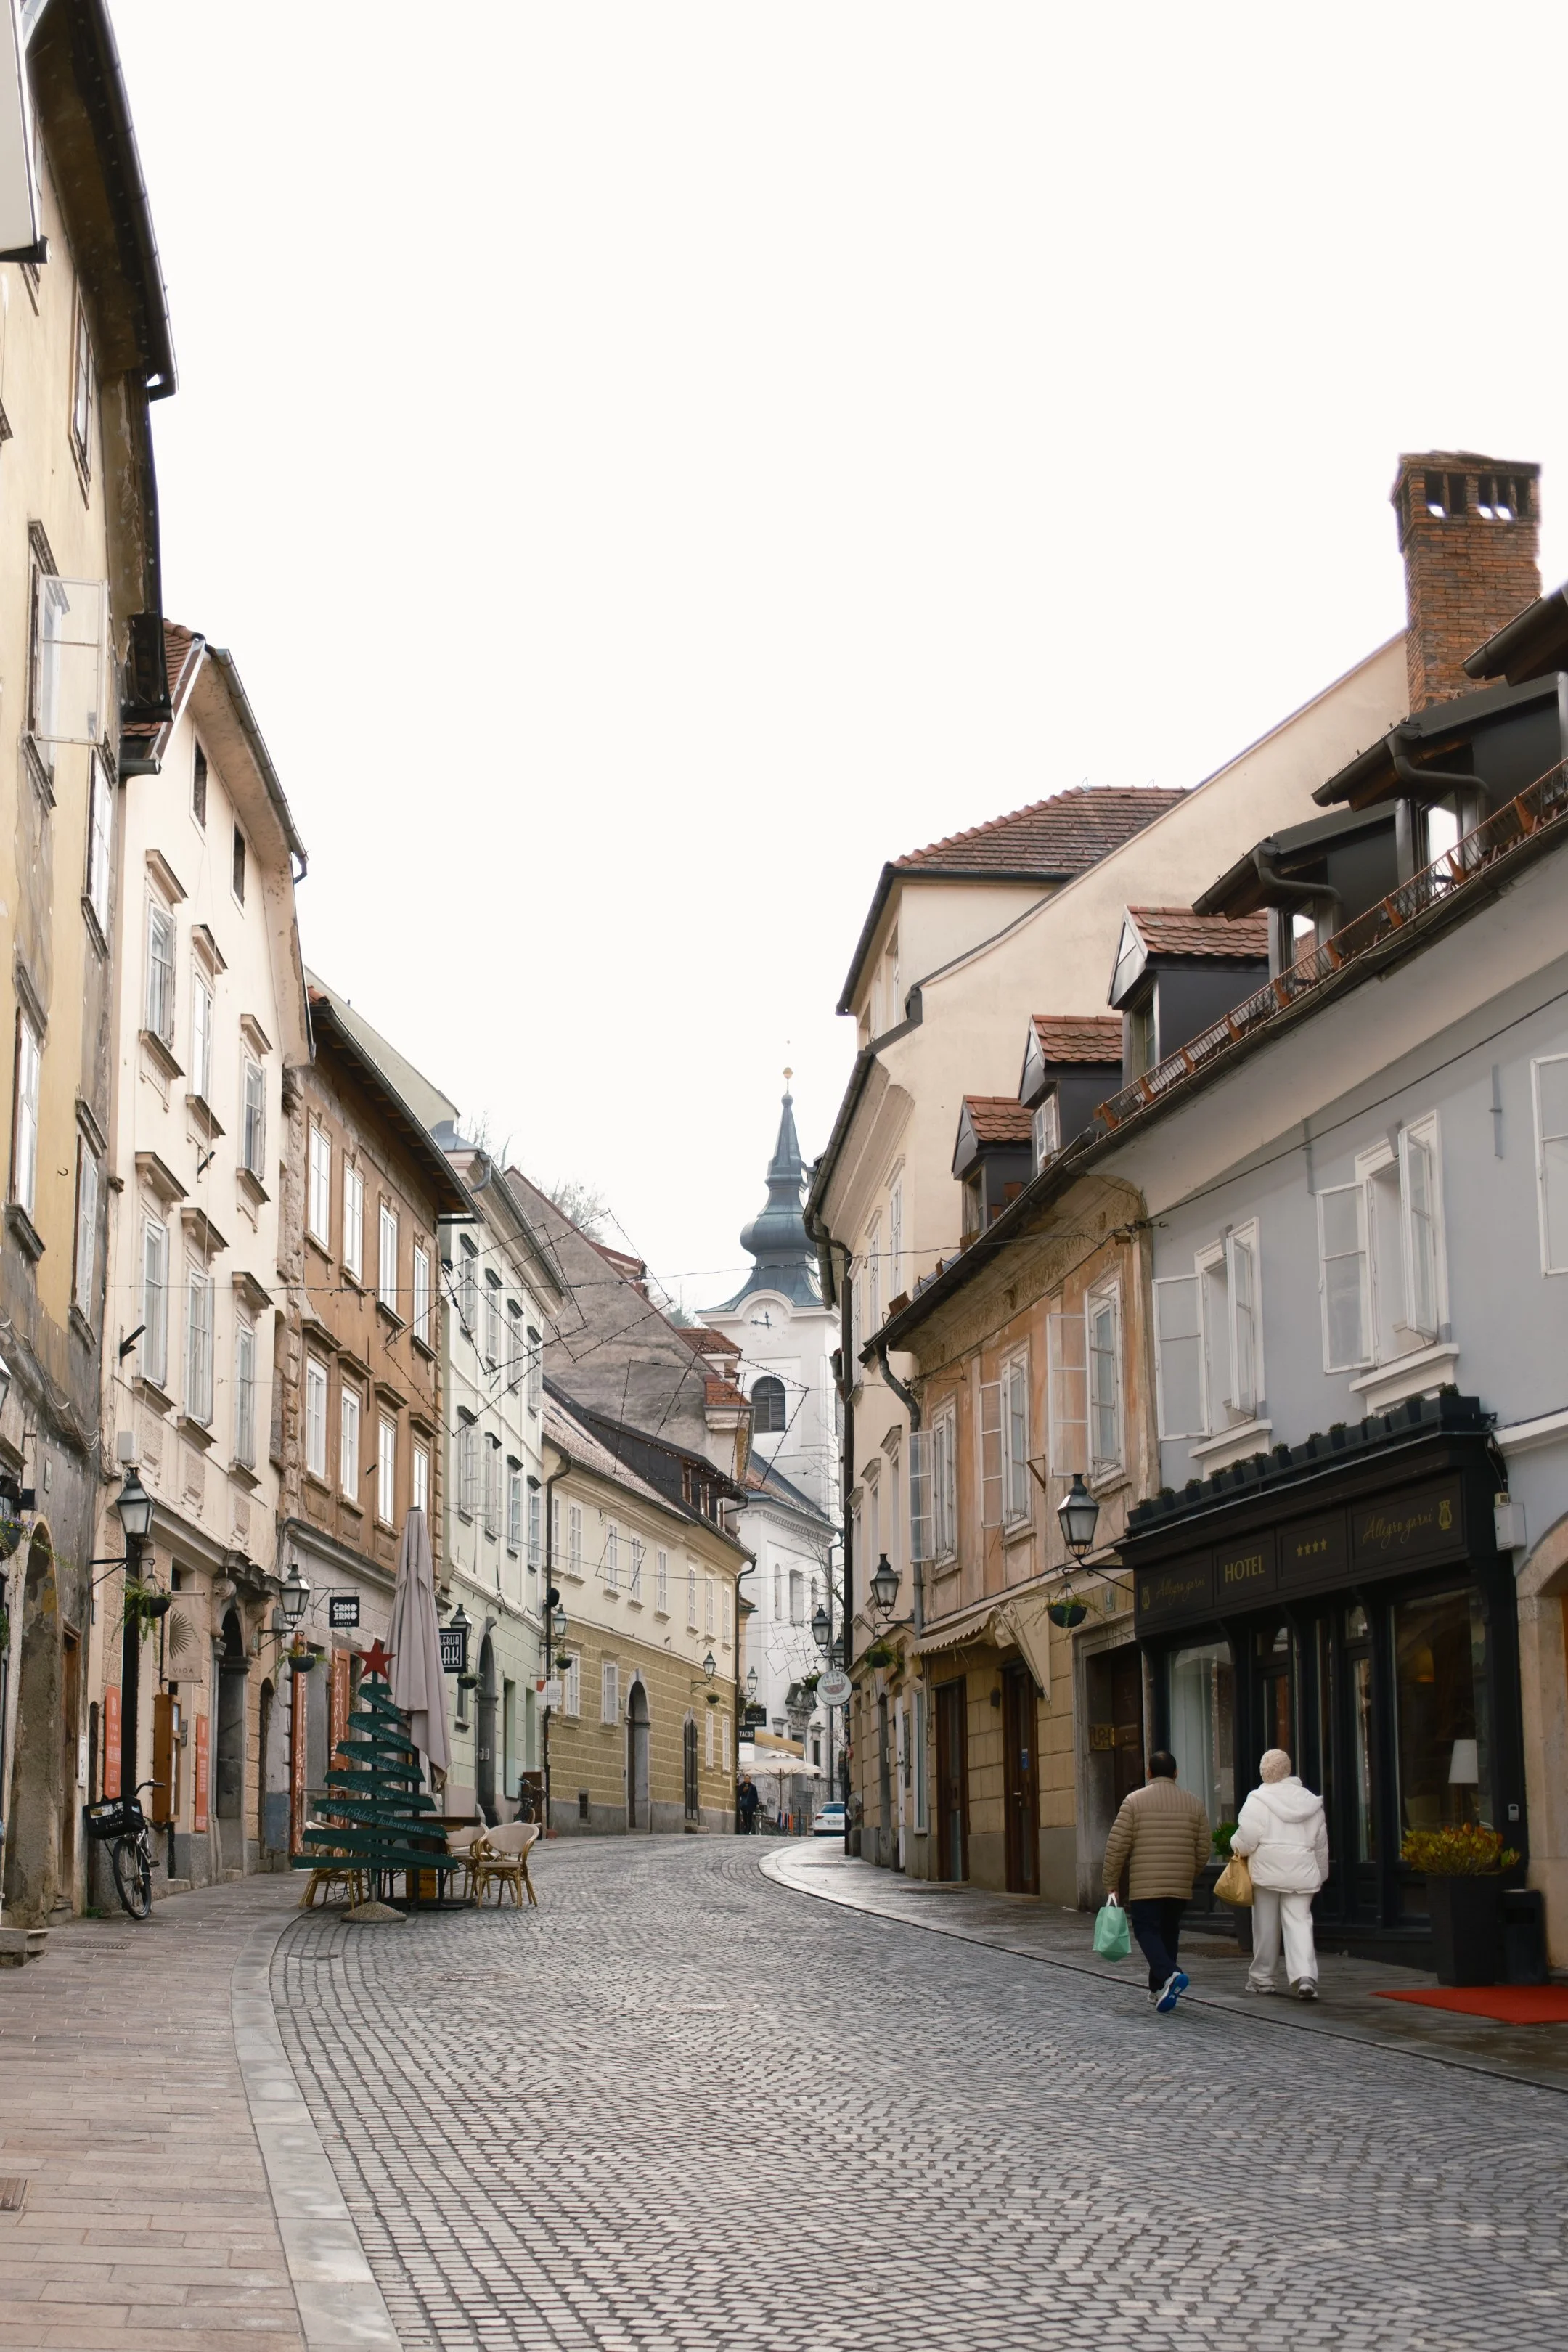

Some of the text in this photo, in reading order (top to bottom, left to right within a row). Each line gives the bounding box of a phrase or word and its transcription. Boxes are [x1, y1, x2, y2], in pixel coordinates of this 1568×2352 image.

[1360, 1508, 1433, 1549] Allegro garni
[1225, 1555, 1265, 1583] HOTEL
[333, 1602, 357, 1612] ČRNO
[440, 1636, 459, 1645] LERIJA
[407, 1824, 425, 1834] vino
